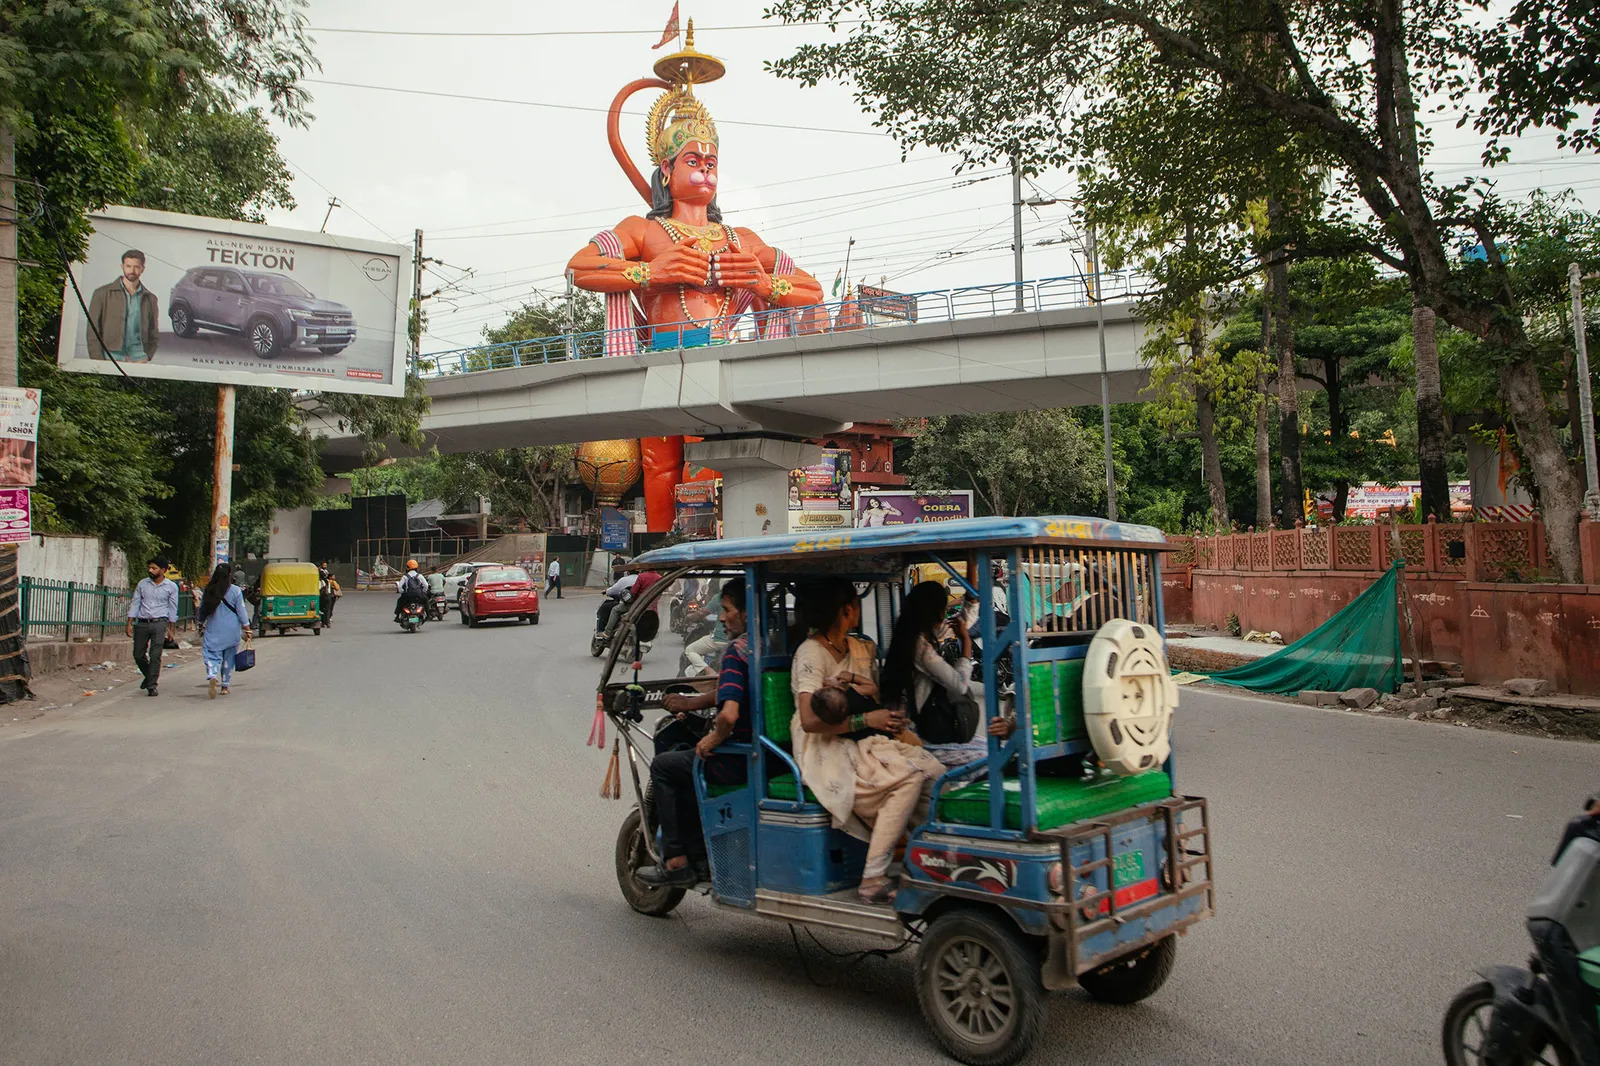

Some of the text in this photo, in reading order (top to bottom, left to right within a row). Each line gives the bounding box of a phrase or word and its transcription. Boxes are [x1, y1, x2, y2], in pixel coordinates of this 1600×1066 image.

[207, 239, 295, 255] ALL-NEW NISSAN
[206, 247, 295, 271] TEKTON
[362, 265, 391, 274] NISSAN
[276, 364, 336, 374] UNMISTAKABLE
[7, 426, 34, 435] ASHOK
[923, 504, 962, 512] COBRA
